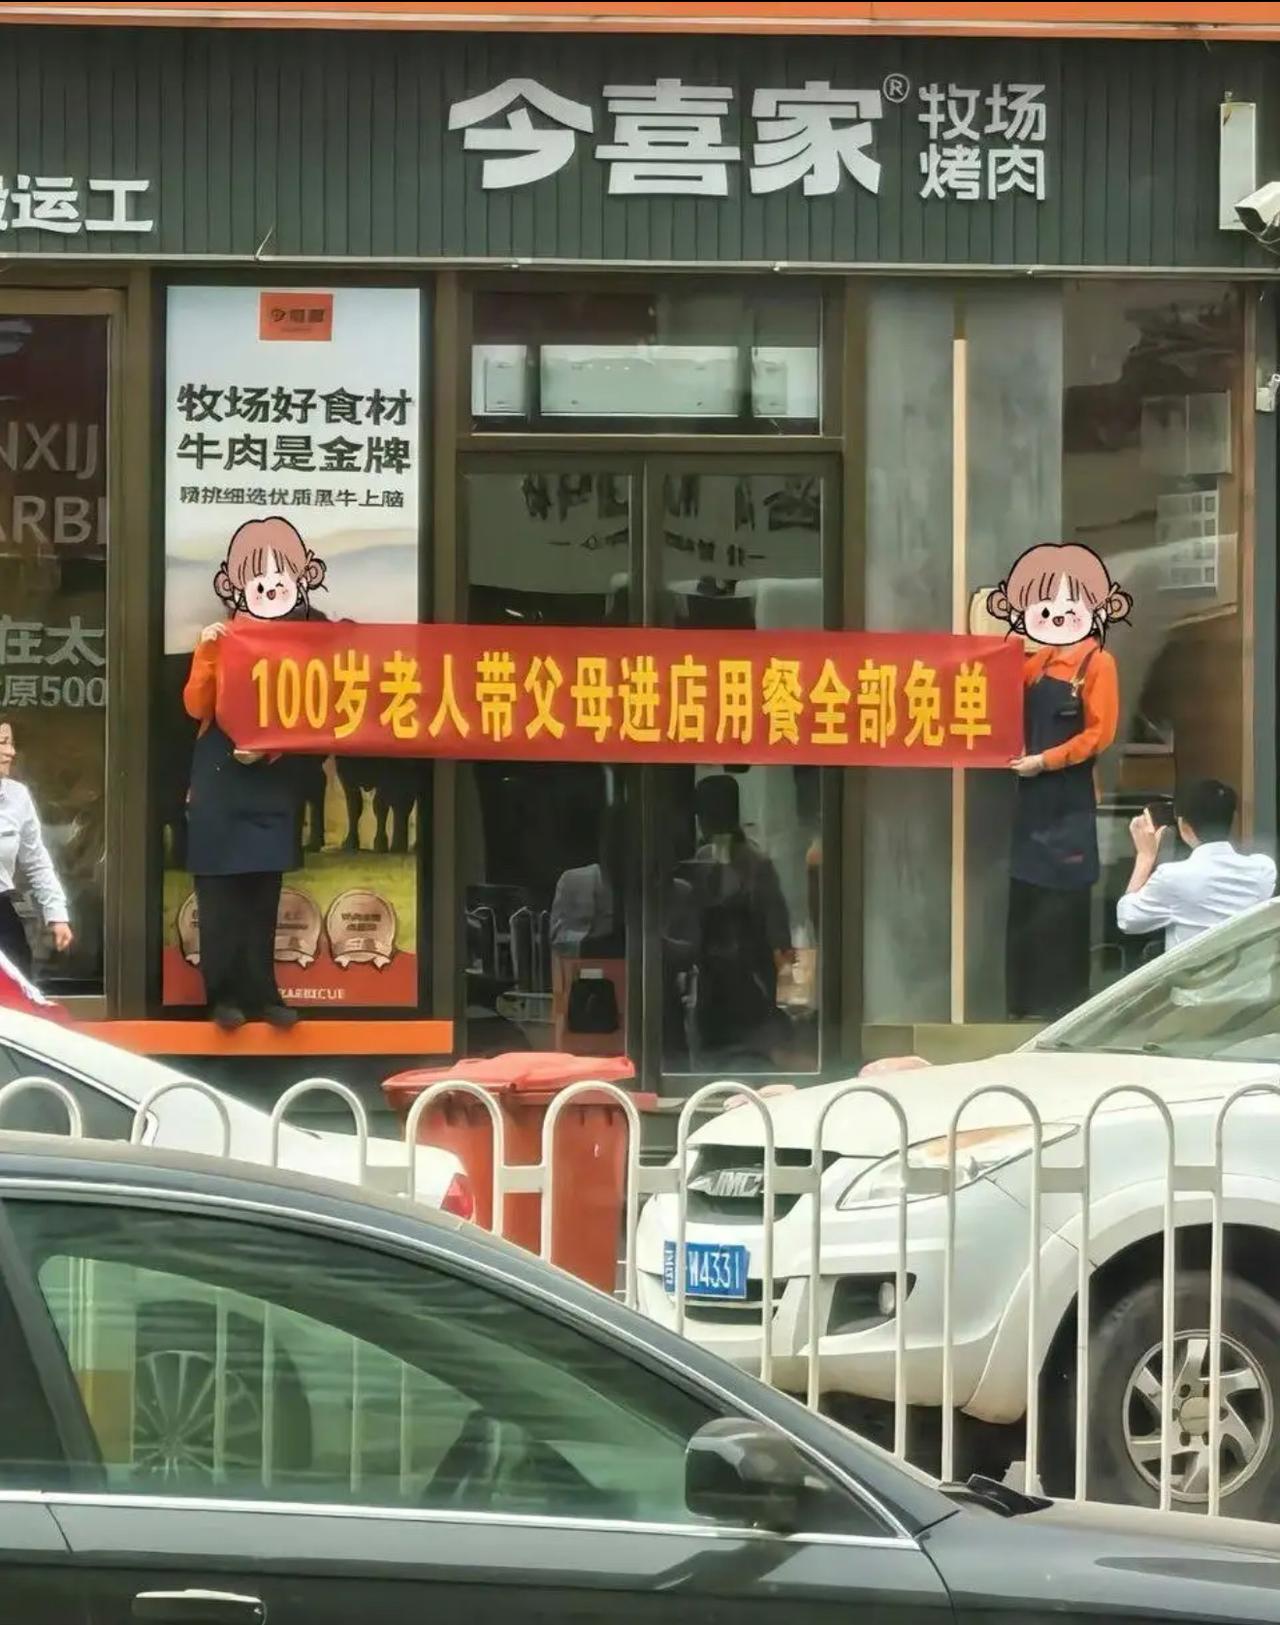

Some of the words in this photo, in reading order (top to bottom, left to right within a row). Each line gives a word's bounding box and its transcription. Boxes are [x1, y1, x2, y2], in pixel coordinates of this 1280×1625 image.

[448, 78, 883, 197] 今喜家
[918, 83, 1047, 141] 牧场
[919, 143, 1046, 200] 烤肉
[0, 174, 154, 233] 运工
[177, 383, 412, 426] 牧场好食材
[177, 432, 411, 474] 牛肉是金牌
[0, 495, 107, 544] RB
[0, 675, 107, 707] 原500
[250, 649, 992, 750] 100岁老人带父母进店用餐全部免单
